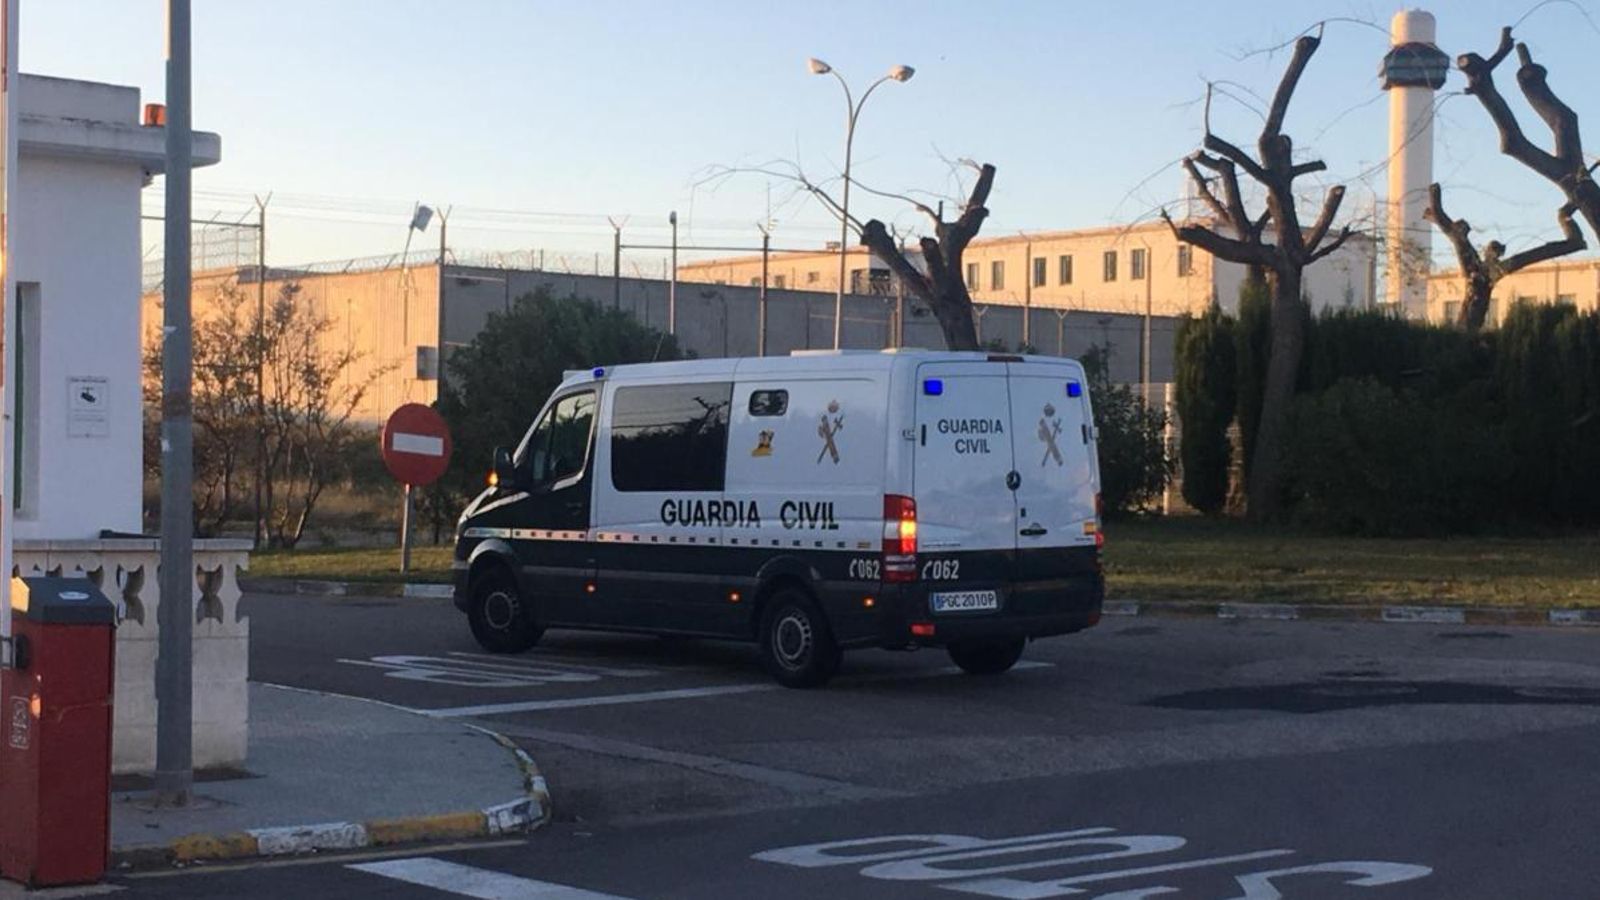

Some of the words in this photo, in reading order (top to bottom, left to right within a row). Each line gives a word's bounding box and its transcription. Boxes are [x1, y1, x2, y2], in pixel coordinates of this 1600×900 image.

[938, 418, 1004, 434] GUARDIA
[955, 438, 991, 454] CIVIL
[660, 498, 761, 528] GUARDIA
[780, 500, 839, 530] CIVIL
[858, 559, 880, 579] 062
[932, 559, 960, 579] 062
